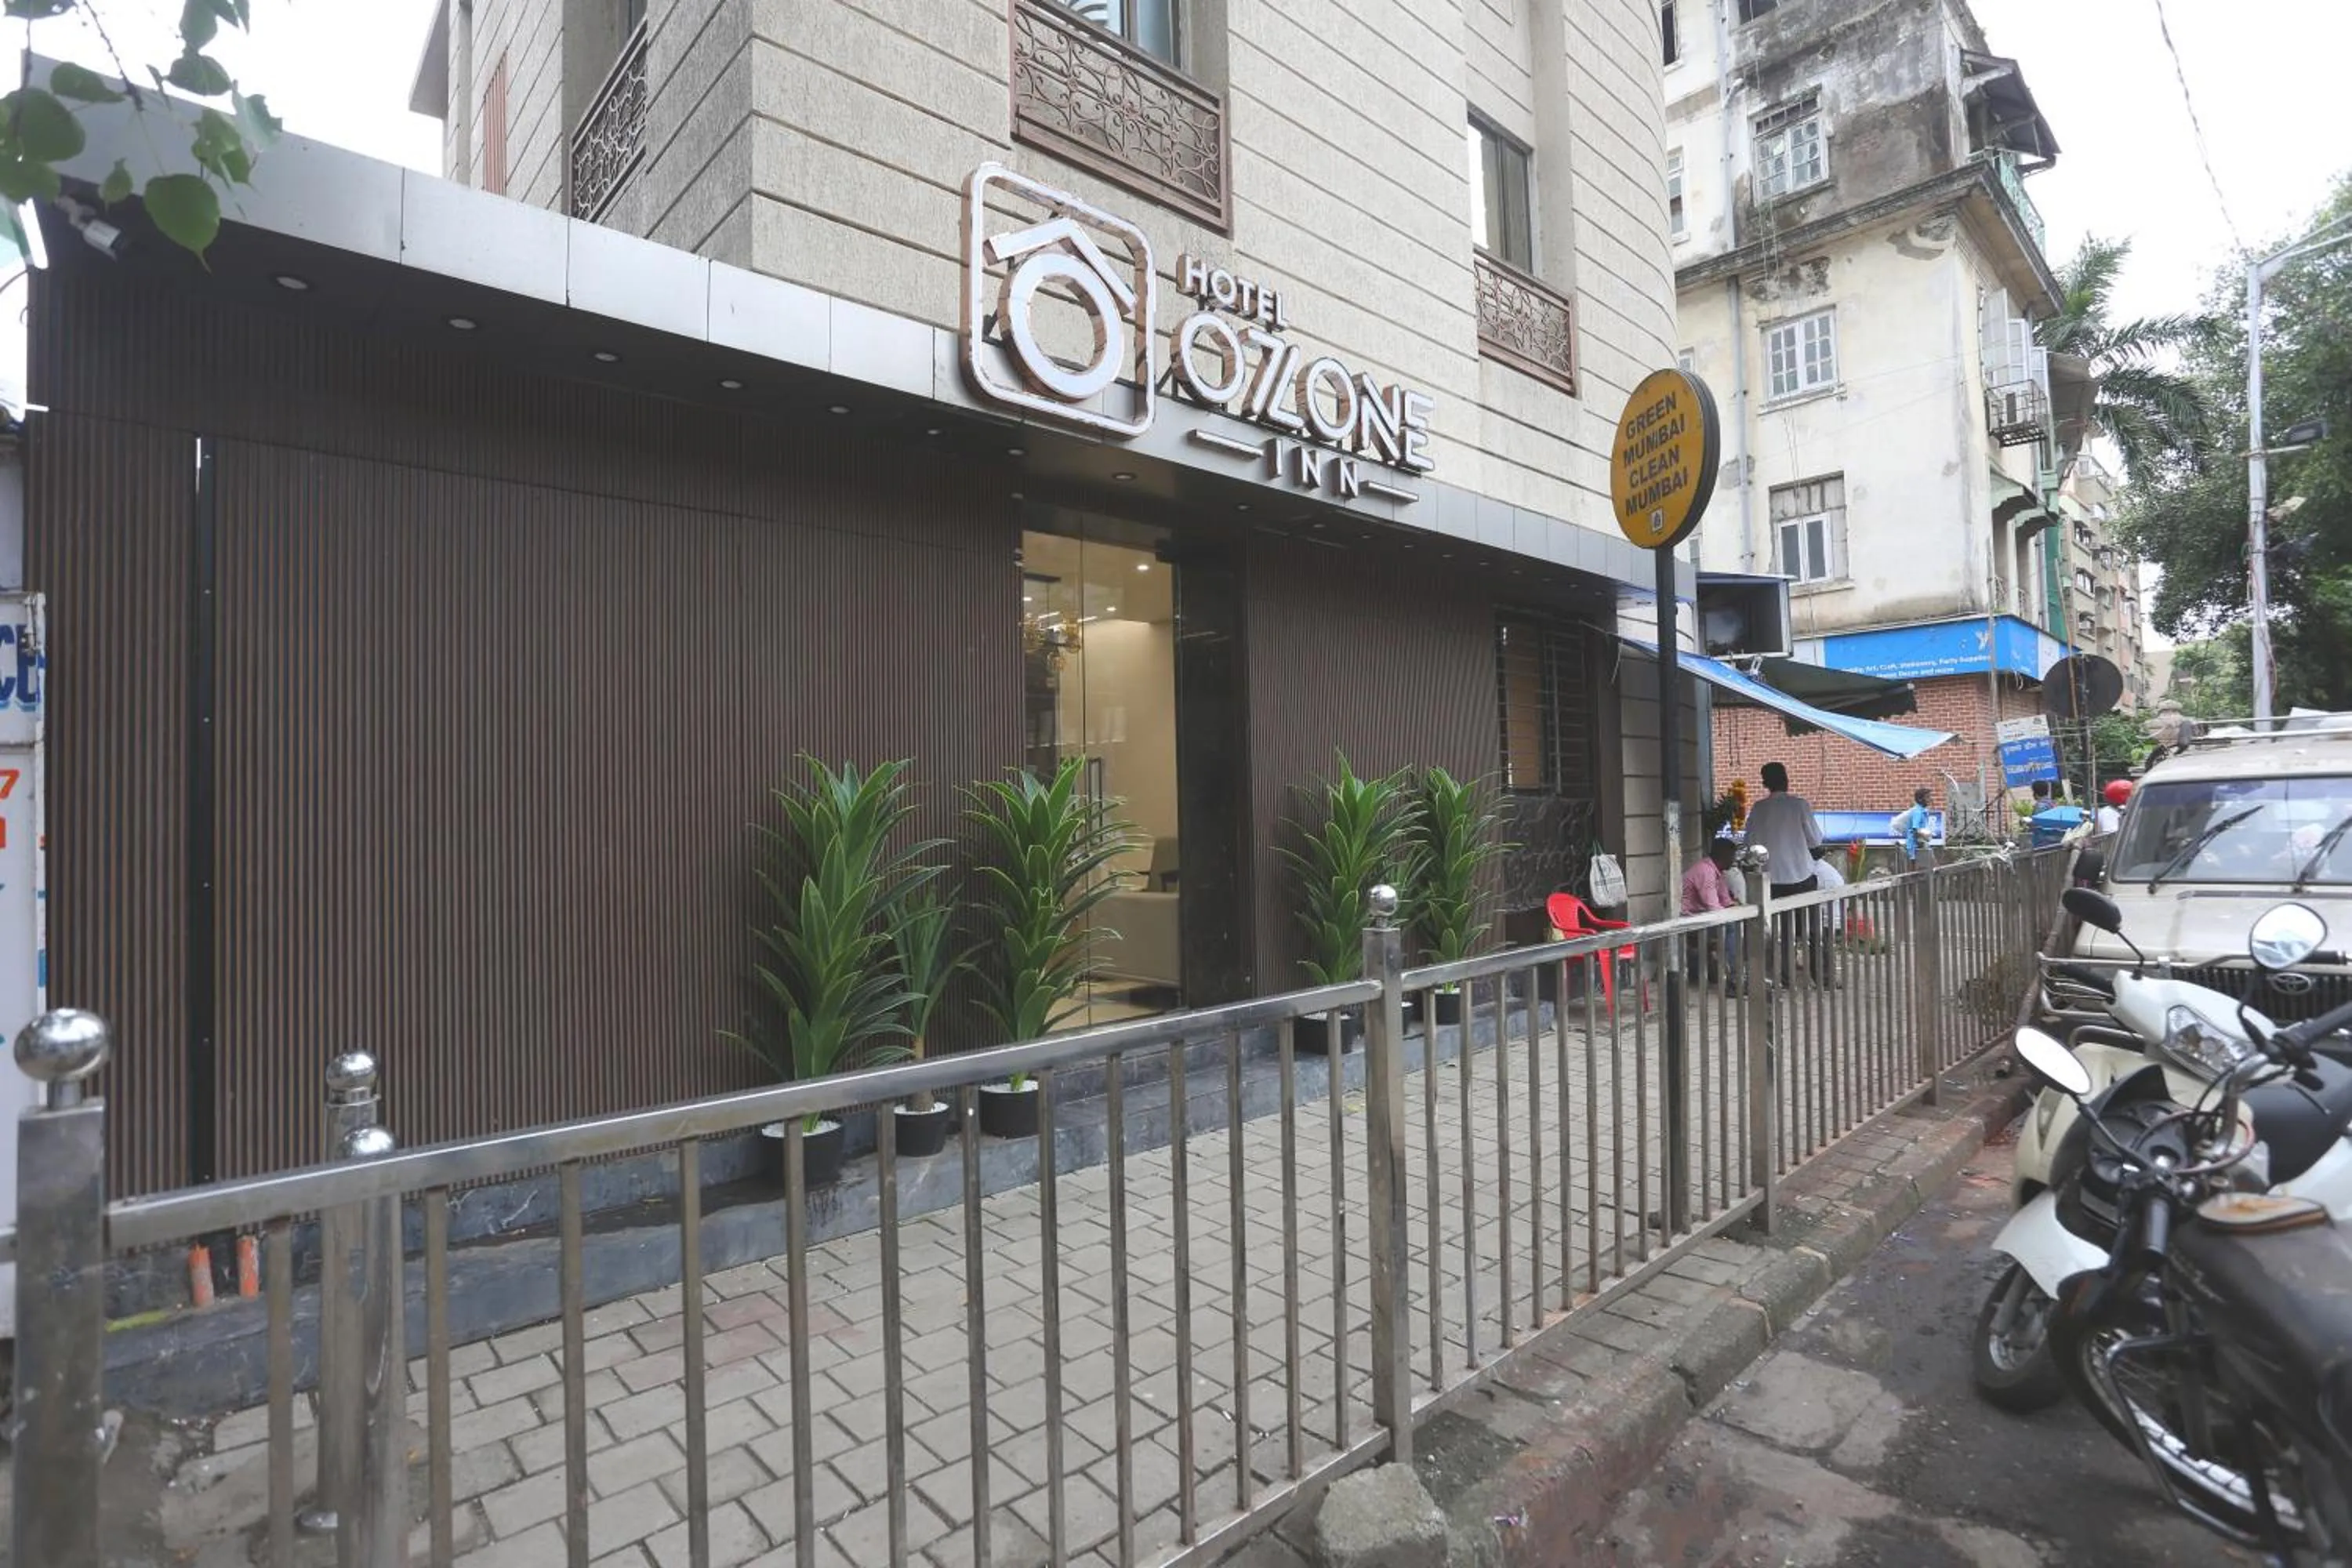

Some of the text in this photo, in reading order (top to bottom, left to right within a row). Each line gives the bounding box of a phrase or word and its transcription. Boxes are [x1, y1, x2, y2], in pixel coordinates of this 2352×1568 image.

[1178, 253, 1288, 327] HOTEL
[1171, 311, 1436, 473] OZONE
[1625, 391, 1677, 441] GREEN
[1265, 437, 1359, 499] INN
[1623, 413, 1686, 468] MUMBAI
[1629, 445, 1681, 489] CLEAN
[1625, 466, 1688, 517] MUMBAI
